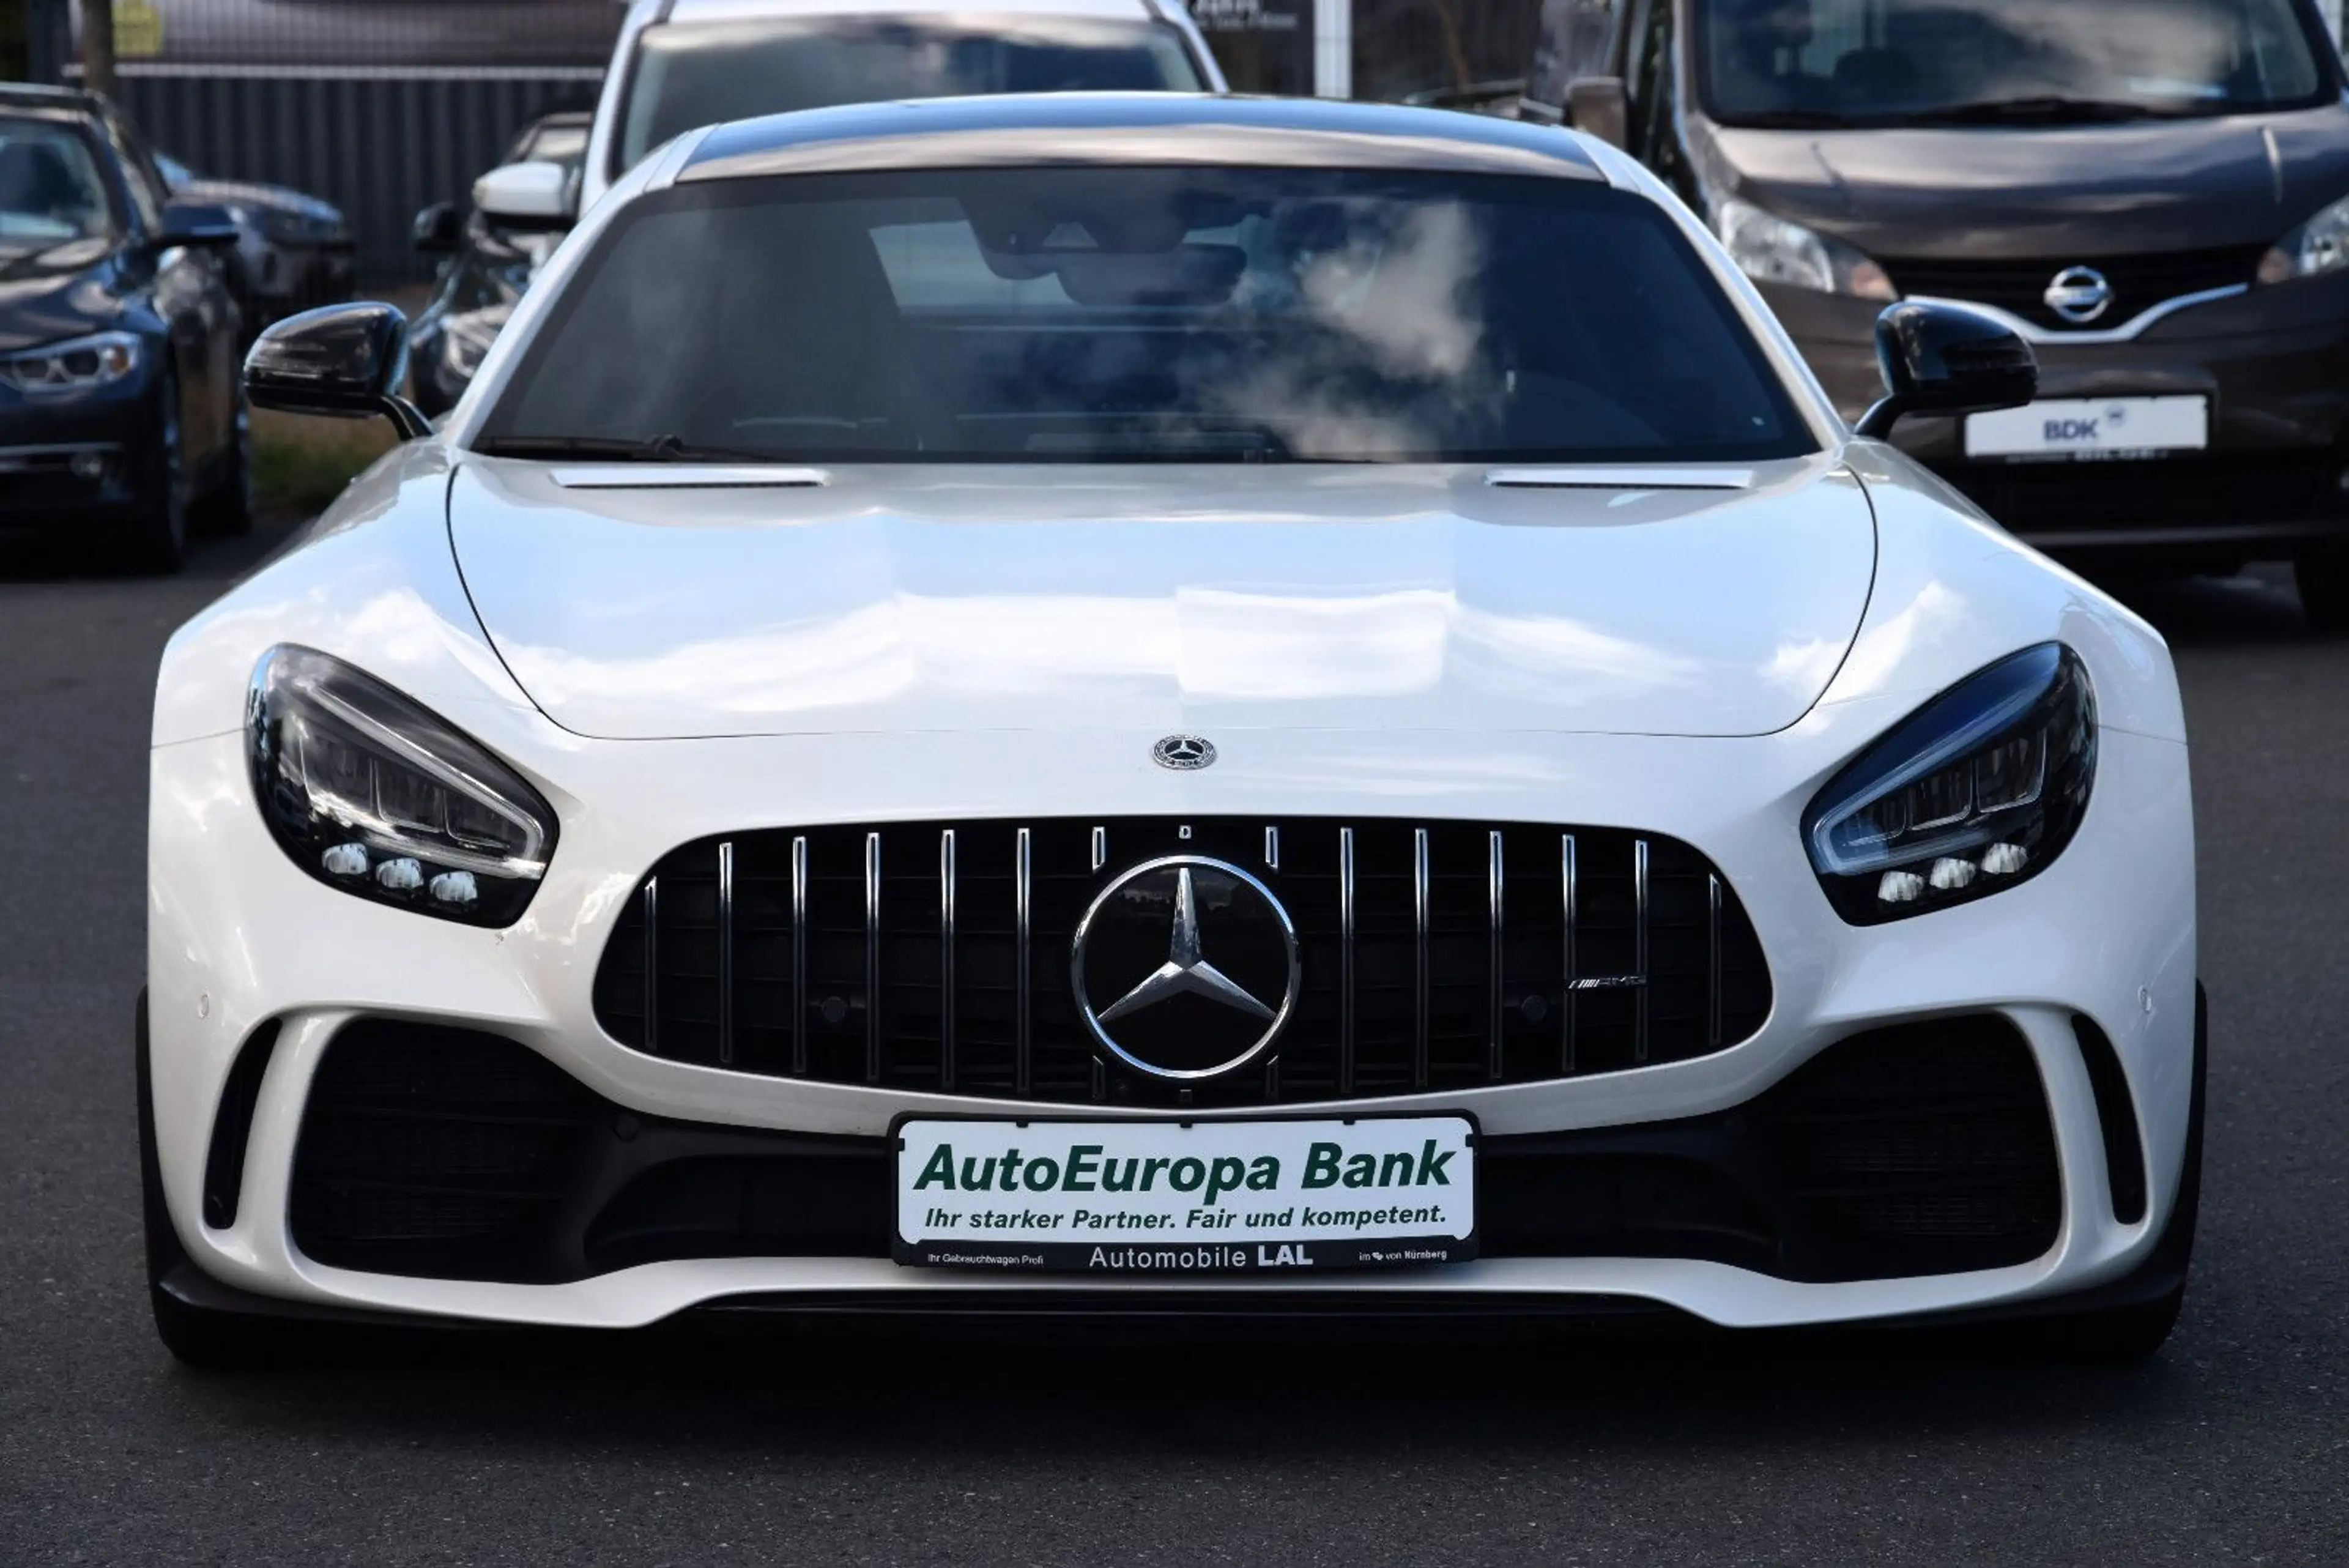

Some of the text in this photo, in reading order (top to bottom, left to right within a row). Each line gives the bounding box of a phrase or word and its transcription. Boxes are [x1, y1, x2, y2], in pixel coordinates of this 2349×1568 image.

[2044, 419, 2099, 442] BDK
[913, 1139, 1457, 1206] AutoEuropa Bank
[925, 1205, 1447, 1231] Ihr starker Partner. Fair und kompetent.
[927, 1254, 1044, 1266] Ihr Gebrauchtwagen Profi
[1089, 1244, 1314, 1268] Automobile LAL
